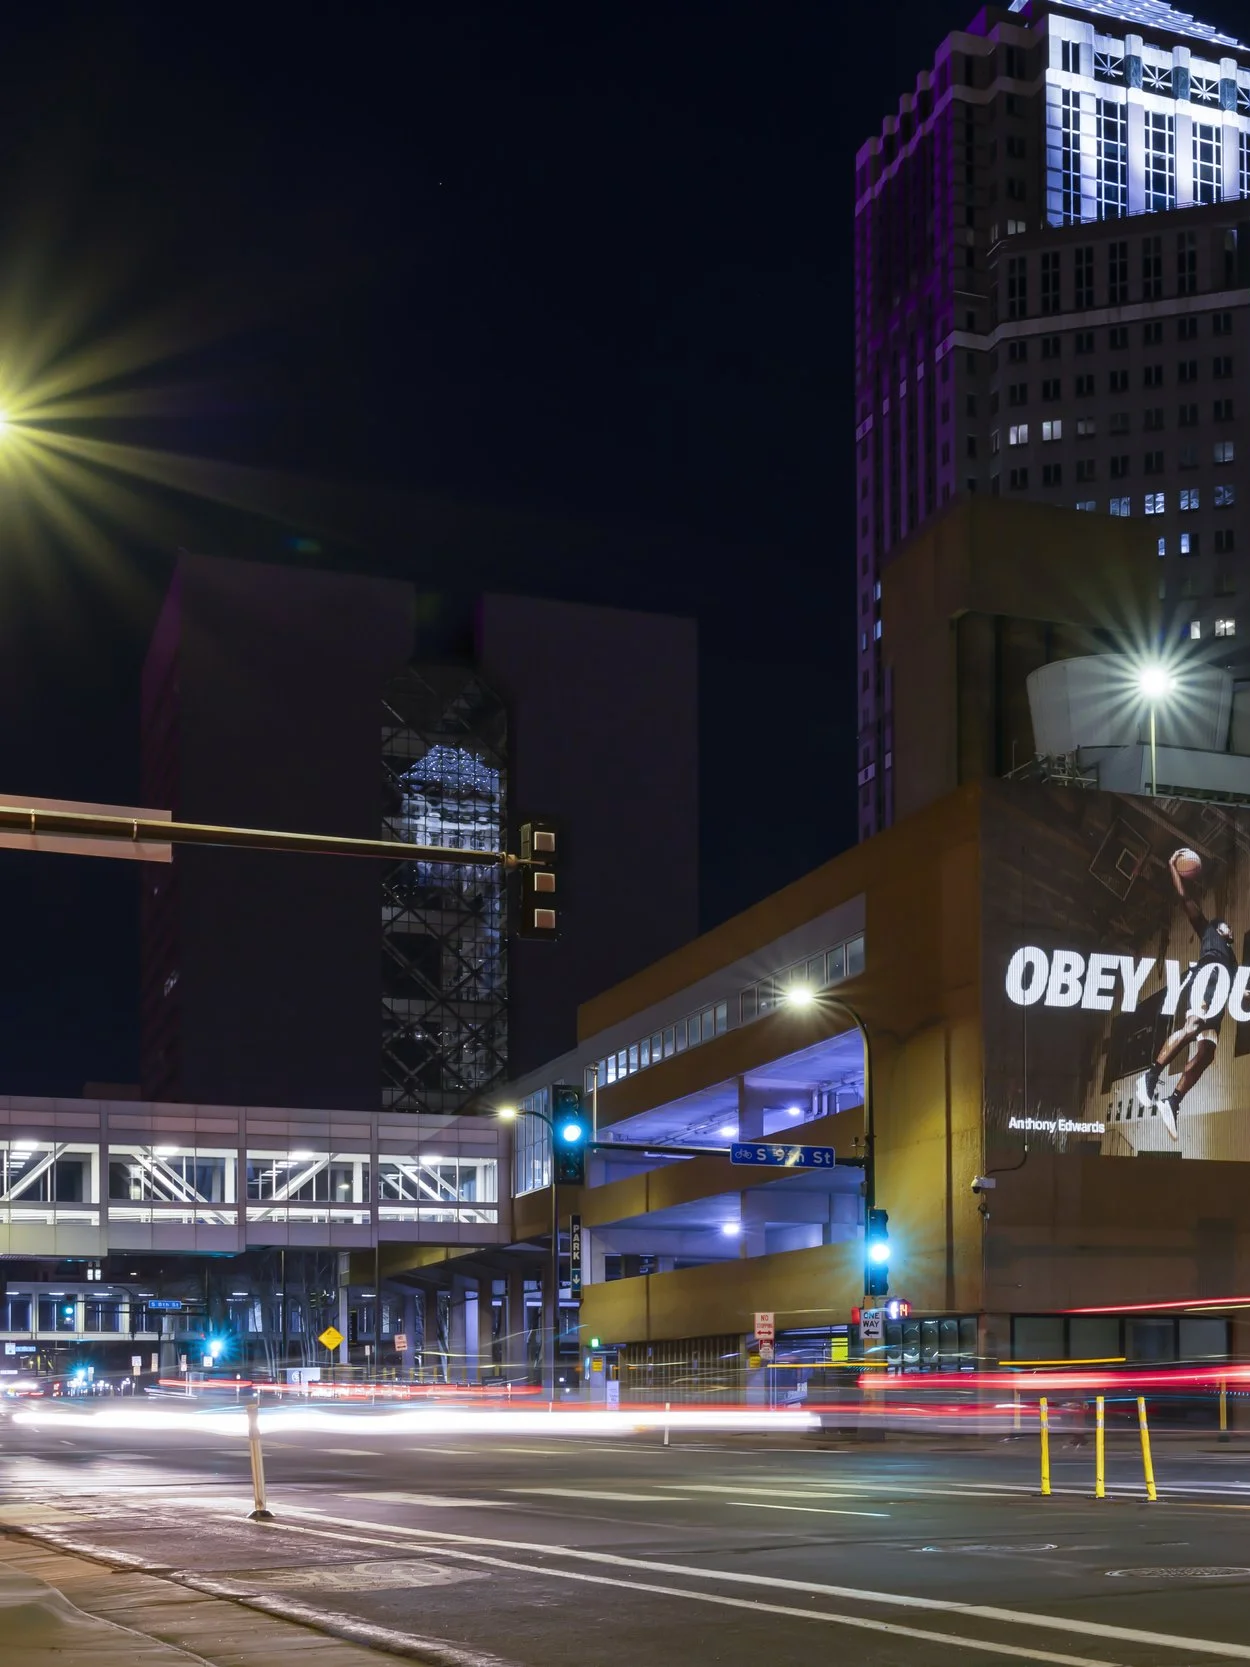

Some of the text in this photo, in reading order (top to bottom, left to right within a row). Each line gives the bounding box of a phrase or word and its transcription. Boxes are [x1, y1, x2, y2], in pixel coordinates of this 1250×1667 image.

[1005, 946, 1156, 1011] OBEY
[1008, 1117, 1105, 1133] Anthony Edwards
[756, 1148, 767, 1161] S
[813, 1151, 831, 1164] St
[863, 1311, 880, 1320] ONE
[863, 1320, 880, 1328] WAY
